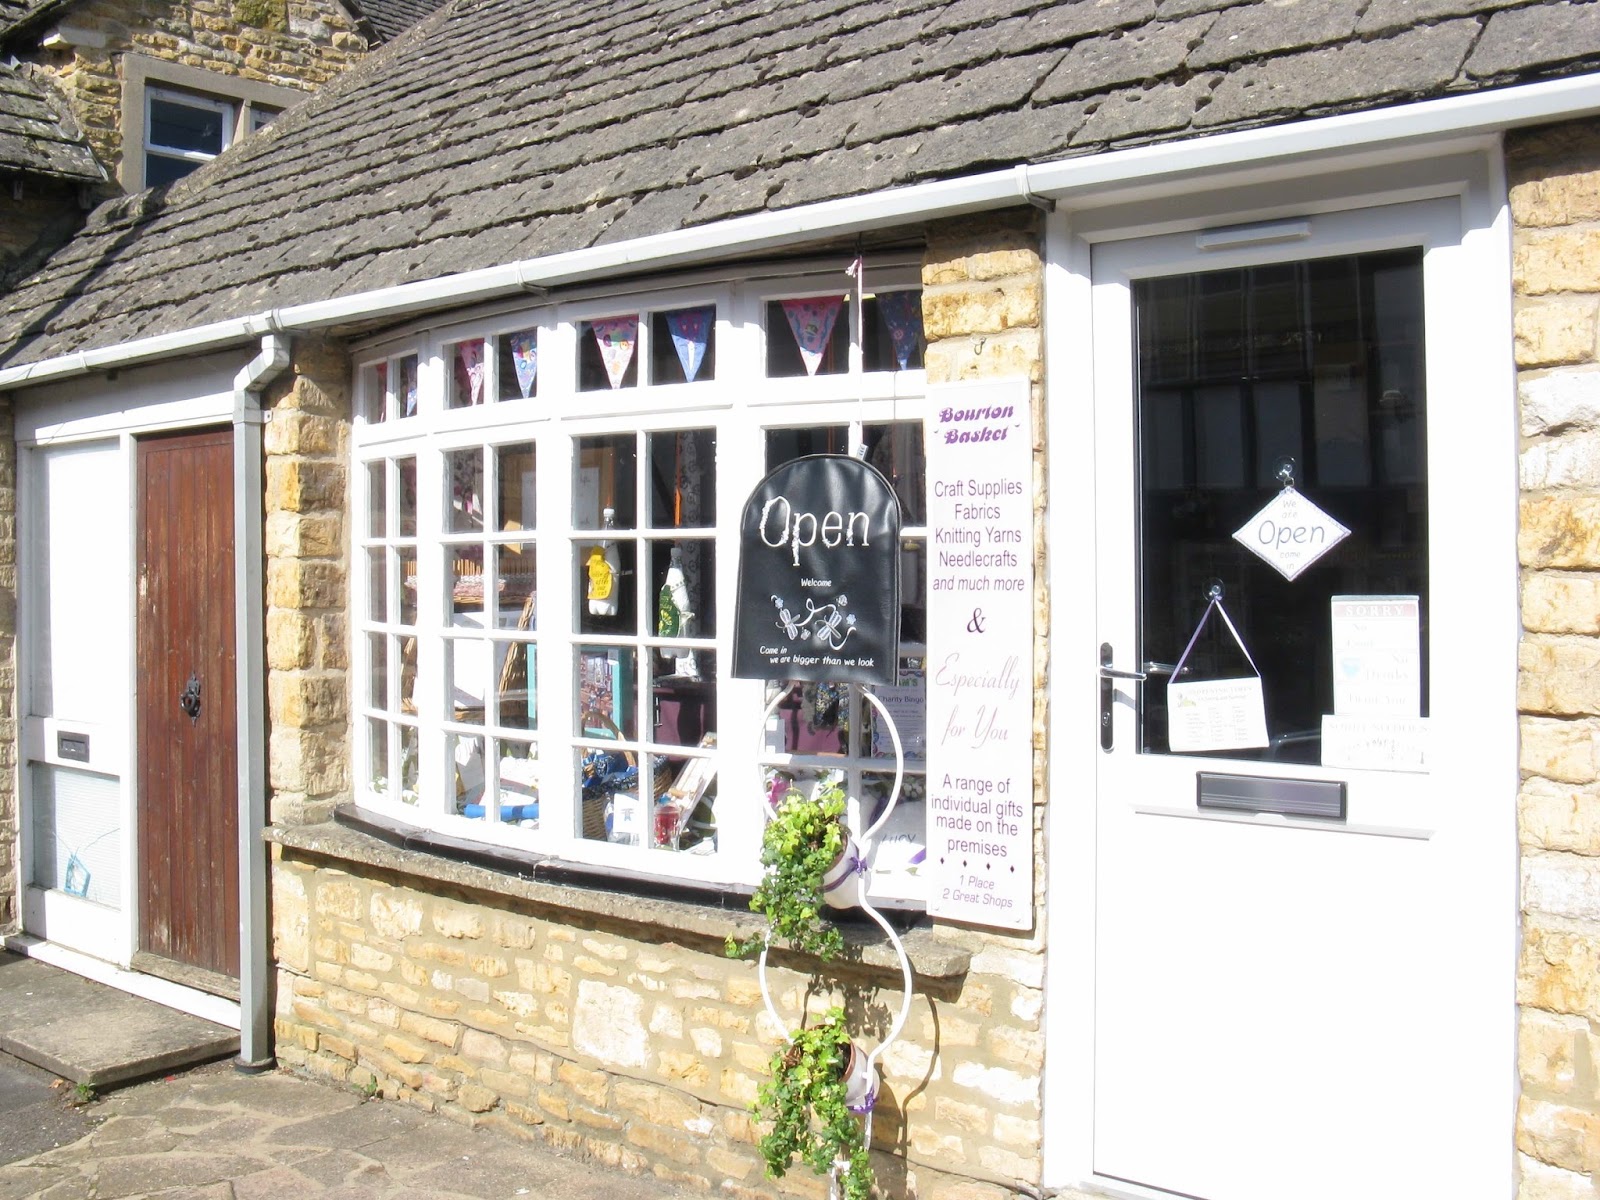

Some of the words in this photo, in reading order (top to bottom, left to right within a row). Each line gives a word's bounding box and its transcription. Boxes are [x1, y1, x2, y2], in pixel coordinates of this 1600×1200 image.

[938, 404, 1014, 423] Bourton
[944, 425, 1009, 445] Basket
[934, 479, 964, 497] Craft
[968, 478, 1022, 499] Supplies
[955, 503, 1000, 519] Fabrics
[1282, 500, 1297, 508] We
[1281, 511, 1298, 519] are
[760, 495, 870, 567] Open
[935, 527, 981, 547] Knitting
[985, 526, 1022, 543] Yarns
[1258, 520, 1325, 550] Open
[939, 550, 1018, 567] Needlecrafts
[1279, 551, 1301, 559] come
[801, 578, 832, 587] Welcome
[933, 575, 955, 590] and
[958, 575, 990, 590] much
[994, 577, 1025, 591] more
[966, 607, 986, 633] &
[1345, 605, 1405, 617] SORRY
[759, 645, 779, 655] Come
[780, 646, 788, 654] in
[792, 656, 820, 667] bigger
[822, 656, 842, 665] than
[844, 658, 855, 666] we
[857, 657, 874, 667] look
[935, 652, 1020, 700] Especially
[879, 695, 902, 703] Charity
[904, 695, 924, 704] Bingo
[941, 704, 965, 746] for
[971, 704, 1009, 749] You
[942, 773, 952, 789] A
[955, 777, 993, 796] range
[998, 778, 1011, 794] of
[931, 794, 992, 815] individual
[996, 800, 1023, 820] gifts
[936, 815, 972, 831] made
[976, 820, 992, 833] on
[997, 819, 1018, 836] the
[948, 838, 1007, 858] premises
[959, 874, 965, 886] 1
[968, 875, 995, 890] Place
[942, 888, 950, 900] 2
[952, 889, 979, 904] Great
[982, 893, 1013, 909] Shops
